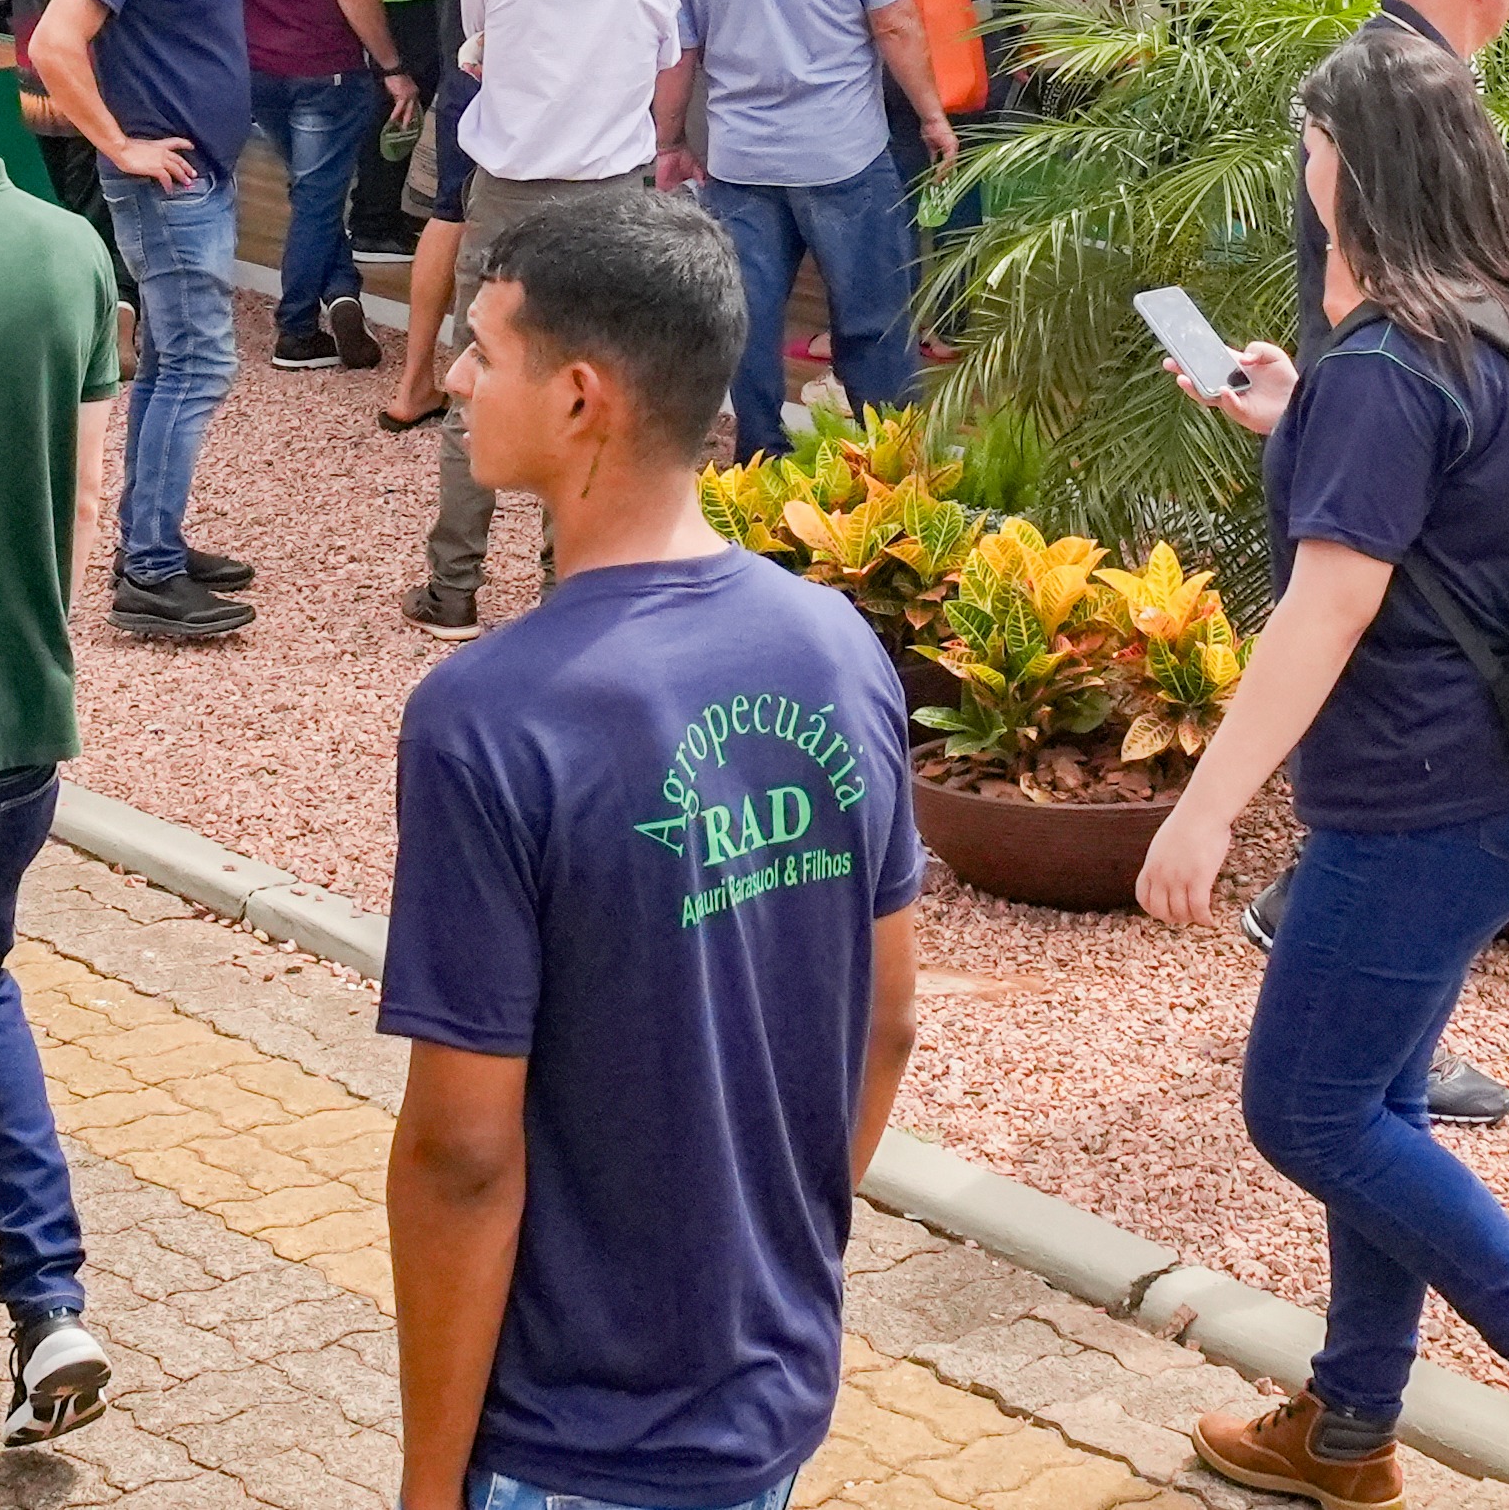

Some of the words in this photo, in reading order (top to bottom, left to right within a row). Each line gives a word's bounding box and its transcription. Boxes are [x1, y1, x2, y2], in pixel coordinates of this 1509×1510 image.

[633, 693, 866, 858] Agropecuária
[701, 786, 811, 867] RAD
[784, 855, 798, 886] &
[802, 848, 852, 884] Filhos
